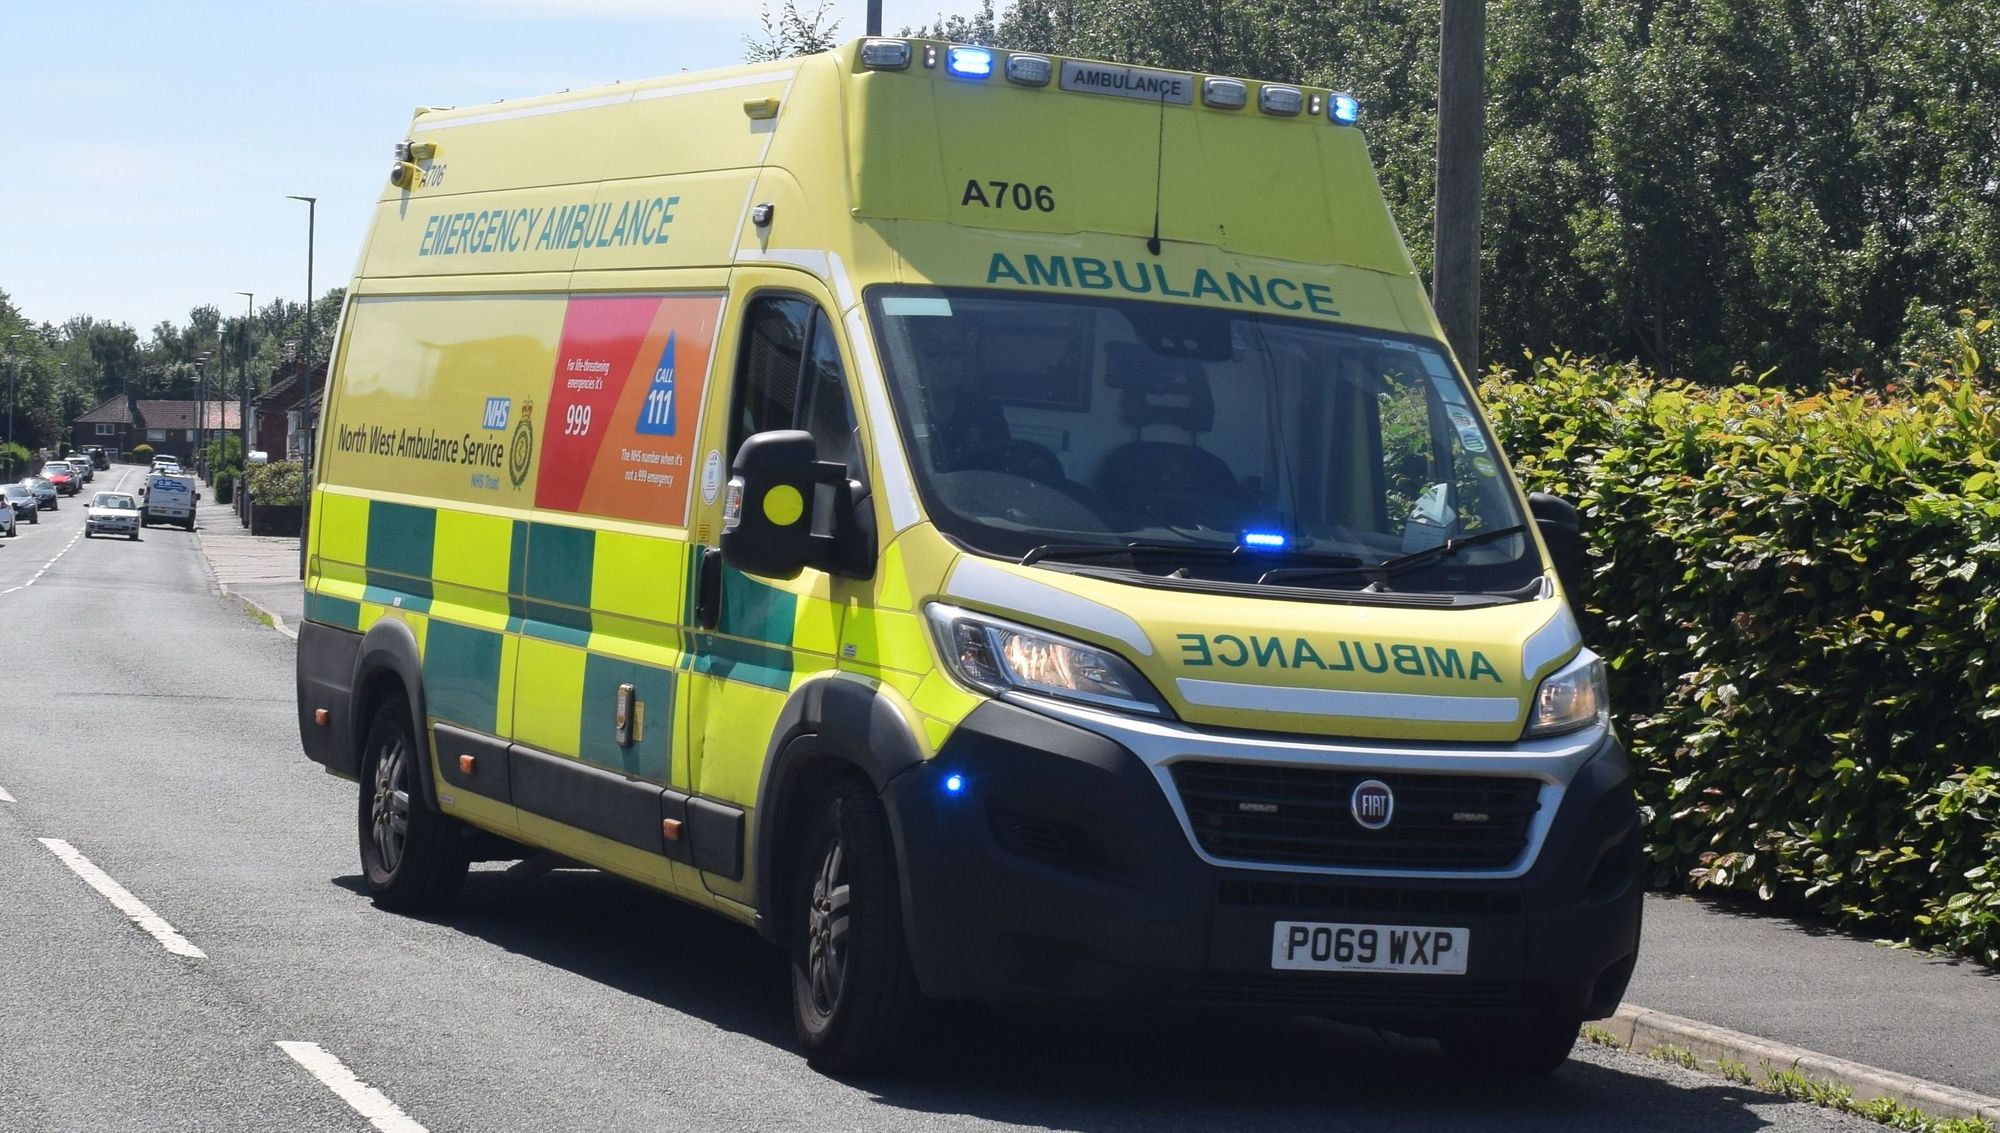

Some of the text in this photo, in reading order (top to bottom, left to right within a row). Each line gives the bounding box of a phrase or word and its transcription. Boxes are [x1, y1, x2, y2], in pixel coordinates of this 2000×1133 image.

[1073, 69, 1182, 96] AMBULANCE
[961, 179, 1055, 213] A706
[418, 196, 680, 256] EMERGENCY AMBULANCE
[986, 252, 1341, 317] AMBULANCE
[655, 368, 674, 383] CALL
[484, 399, 510, 429] NHS
[565, 404, 591, 436] 999
[647, 389, 672, 425] 111
[337, 423, 504, 468] North West Ambulance Service
[1362, 795, 1387, 816] FIAT
[1287, 926, 1453, 966] PO69 WXP
